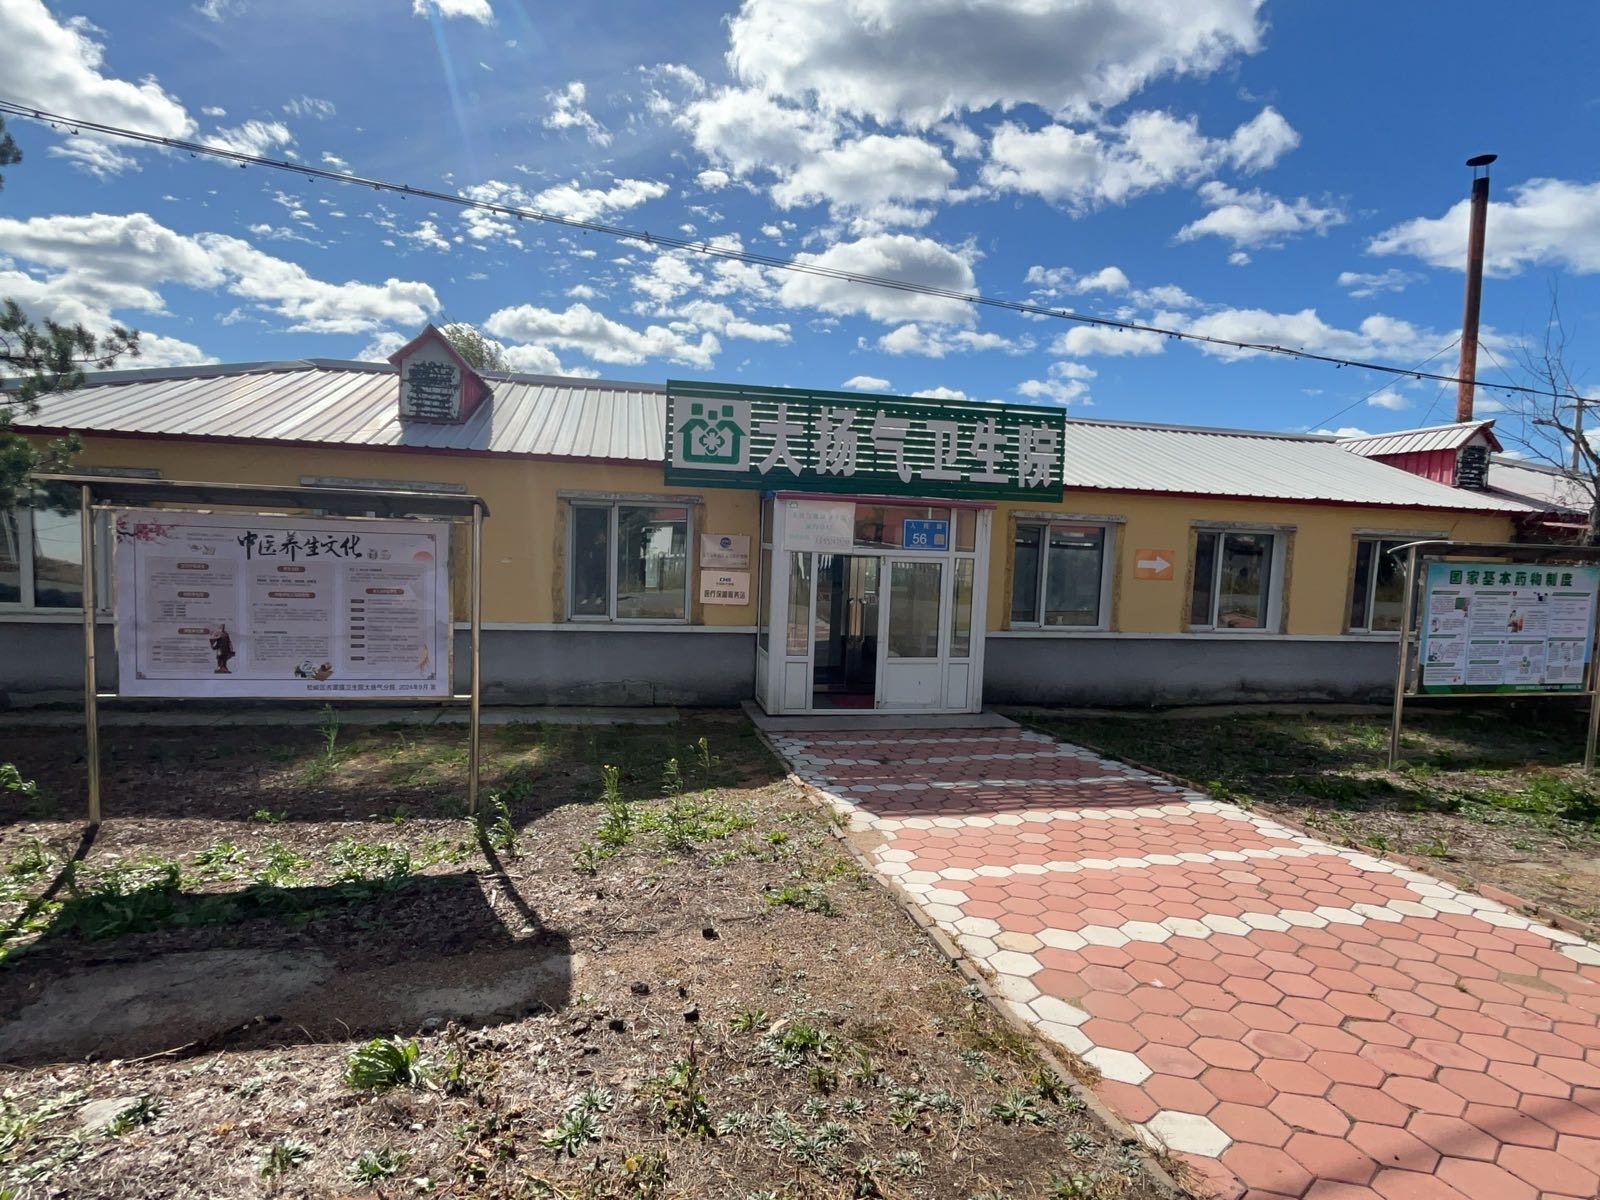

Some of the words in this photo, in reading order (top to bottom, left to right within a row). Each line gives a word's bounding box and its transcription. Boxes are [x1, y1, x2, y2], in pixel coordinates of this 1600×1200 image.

[757, 403, 1057, 488] 大扬气卫生院
[237, 530, 363, 562] 中医养生文化
[912, 533, 928, 545] 56
[1449, 569, 1573, 587] 国家基本药物制度
